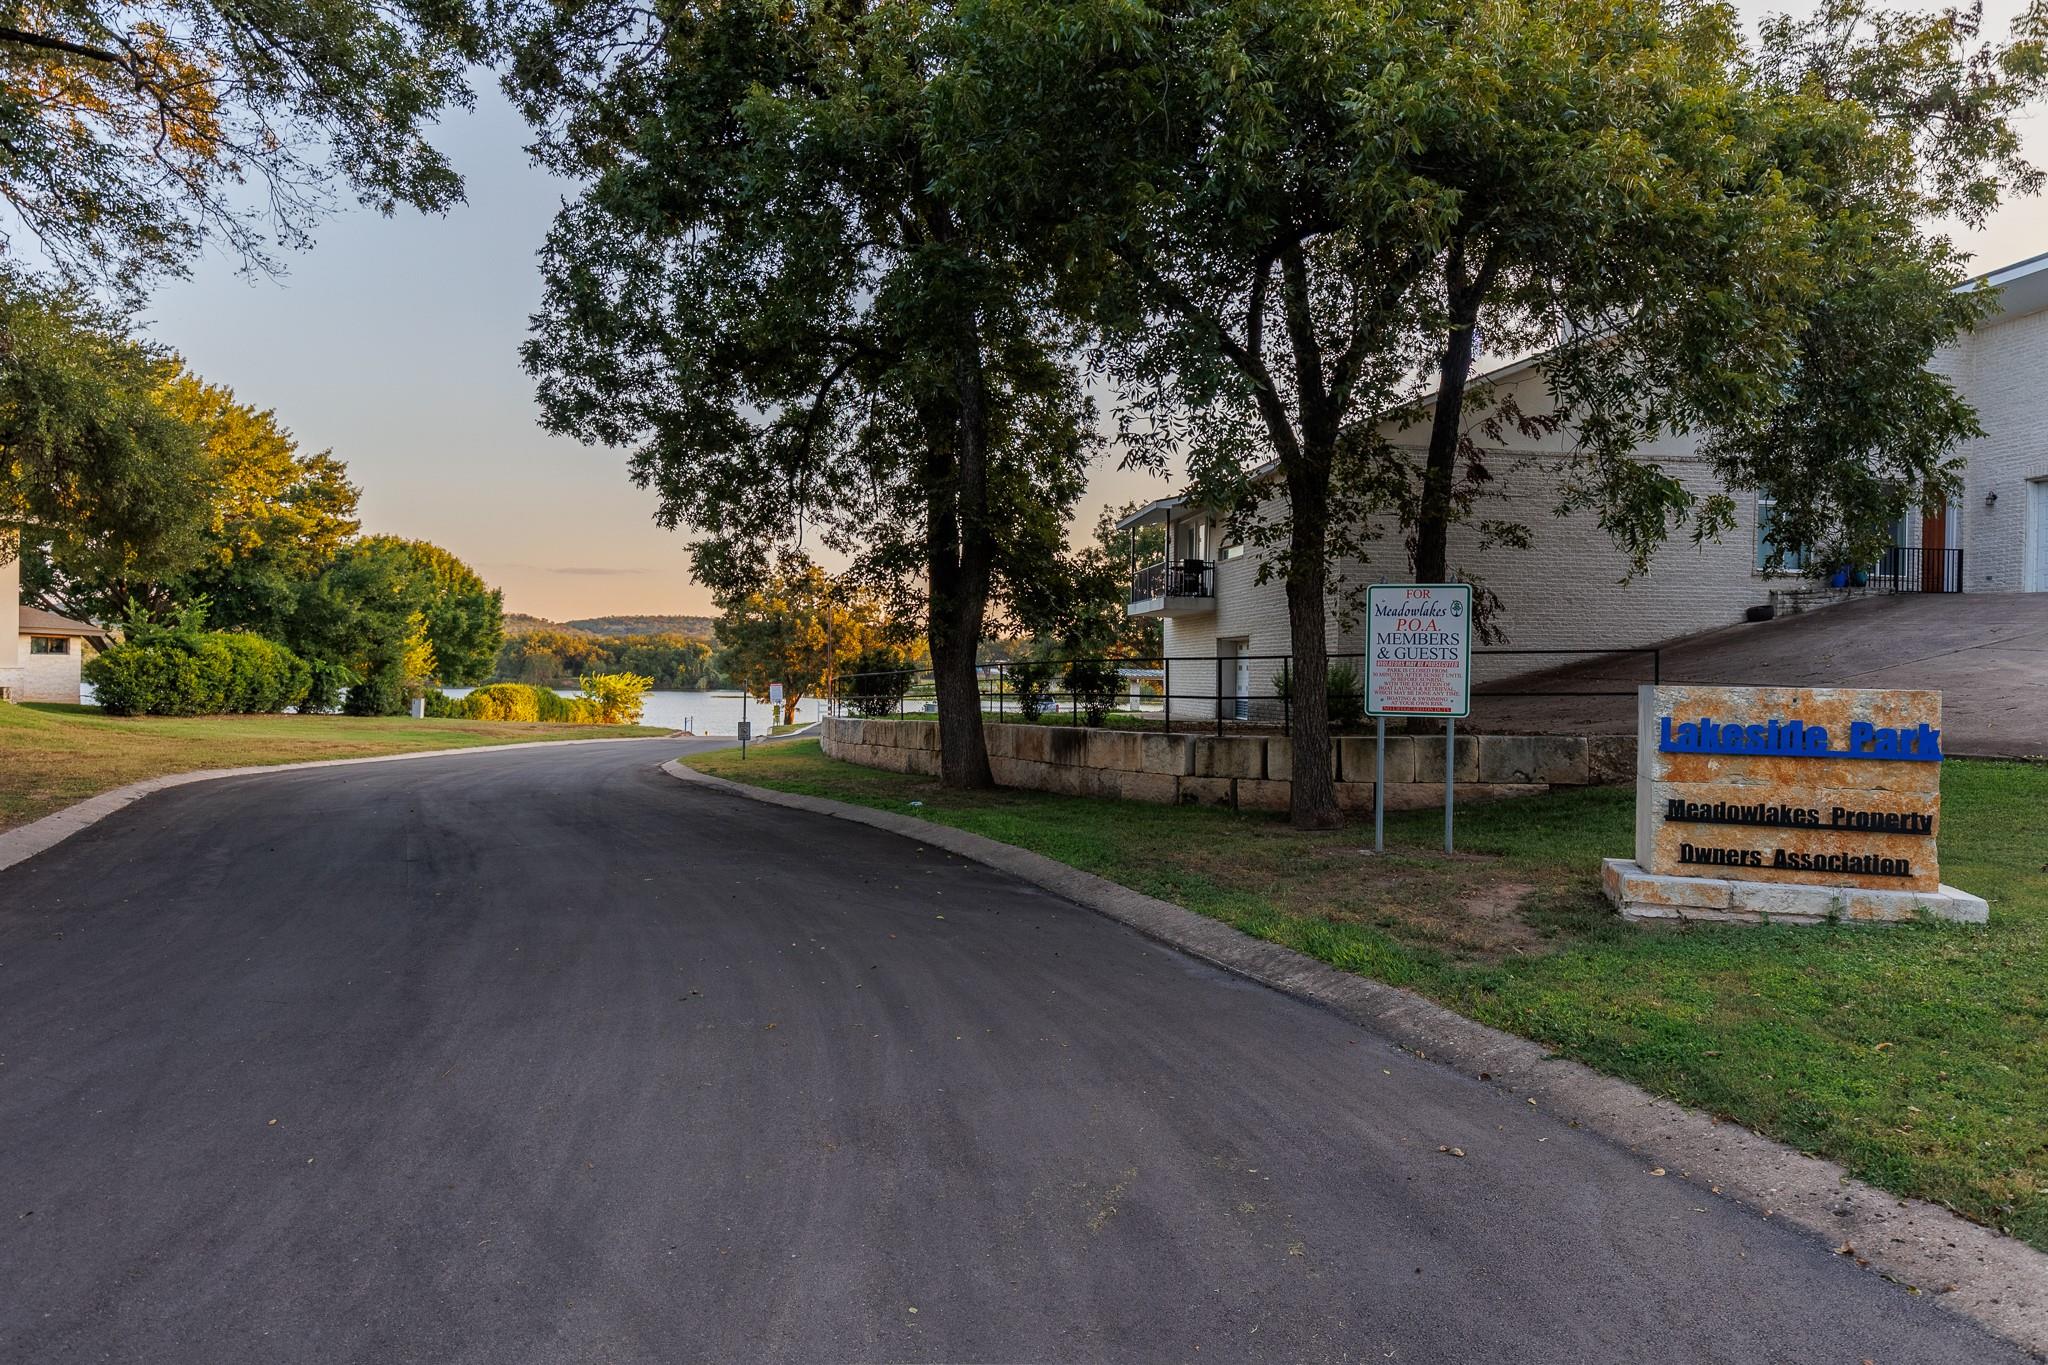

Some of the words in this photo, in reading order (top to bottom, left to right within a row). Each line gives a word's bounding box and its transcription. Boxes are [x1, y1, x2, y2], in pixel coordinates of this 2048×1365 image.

[1406, 589, 1431, 599] FOR
[1374, 600, 1447, 617] Meadowlakes
[1396, 618, 1441, 632] P.O.A.
[1377, 632, 1460, 646] MEMBERS
[1377, 647, 1389, 660] &
[1394, 646, 1458, 660] GUESTS
[1660, 716, 1828, 754] Lakeside
[1850, 721, 1942, 758] Park
[1668, 799, 1820, 827] Meadowlakes
[1832, 807, 1933, 834] Property
[1680, 843, 1762, 866] Owners
[1773, 848, 1910, 875] Association
